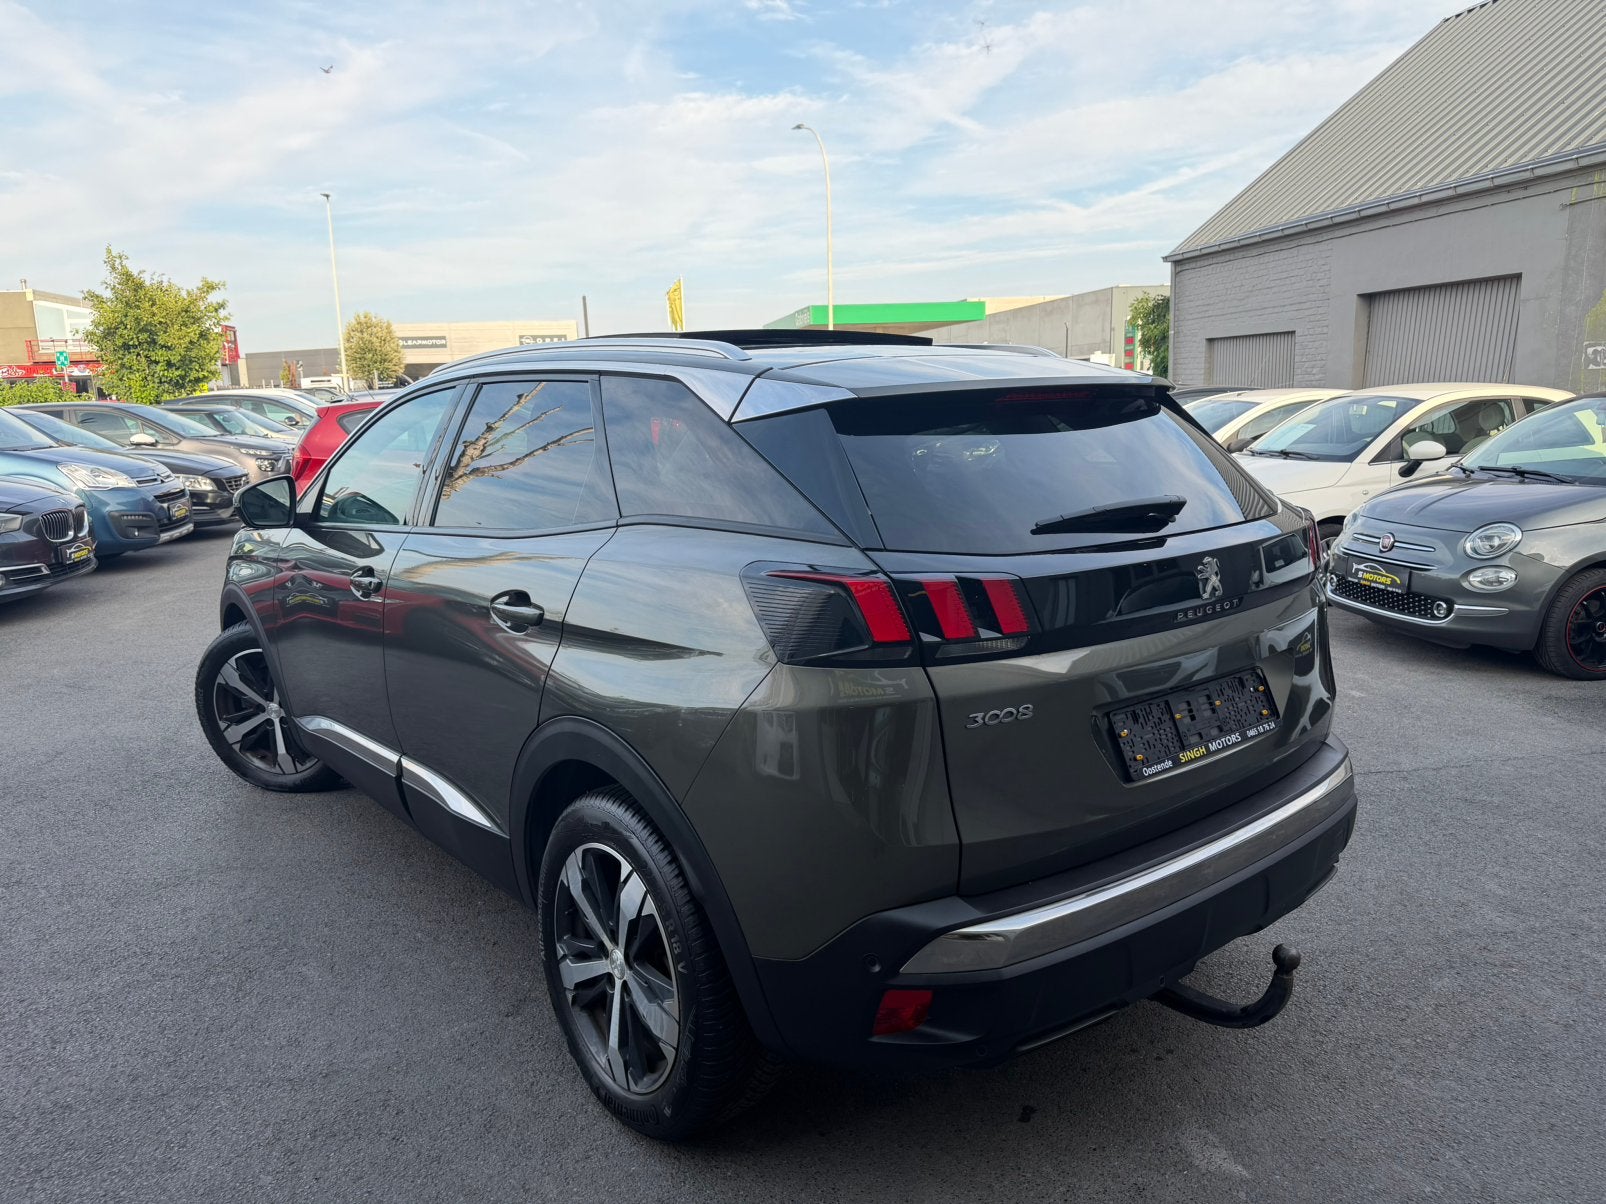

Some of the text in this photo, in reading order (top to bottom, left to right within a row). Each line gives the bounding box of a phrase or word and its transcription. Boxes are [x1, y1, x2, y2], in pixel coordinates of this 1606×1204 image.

[1363, 573, 1391, 584] MOTORS
[1177, 599, 1239, 621] PEUGEOT
[965, 703, 1034, 729] 3008
[1142, 759, 1174, 776] Oostende
[1179, 746, 1207, 763] SINGH
[1208, 732, 1242, 752] MOTORS
